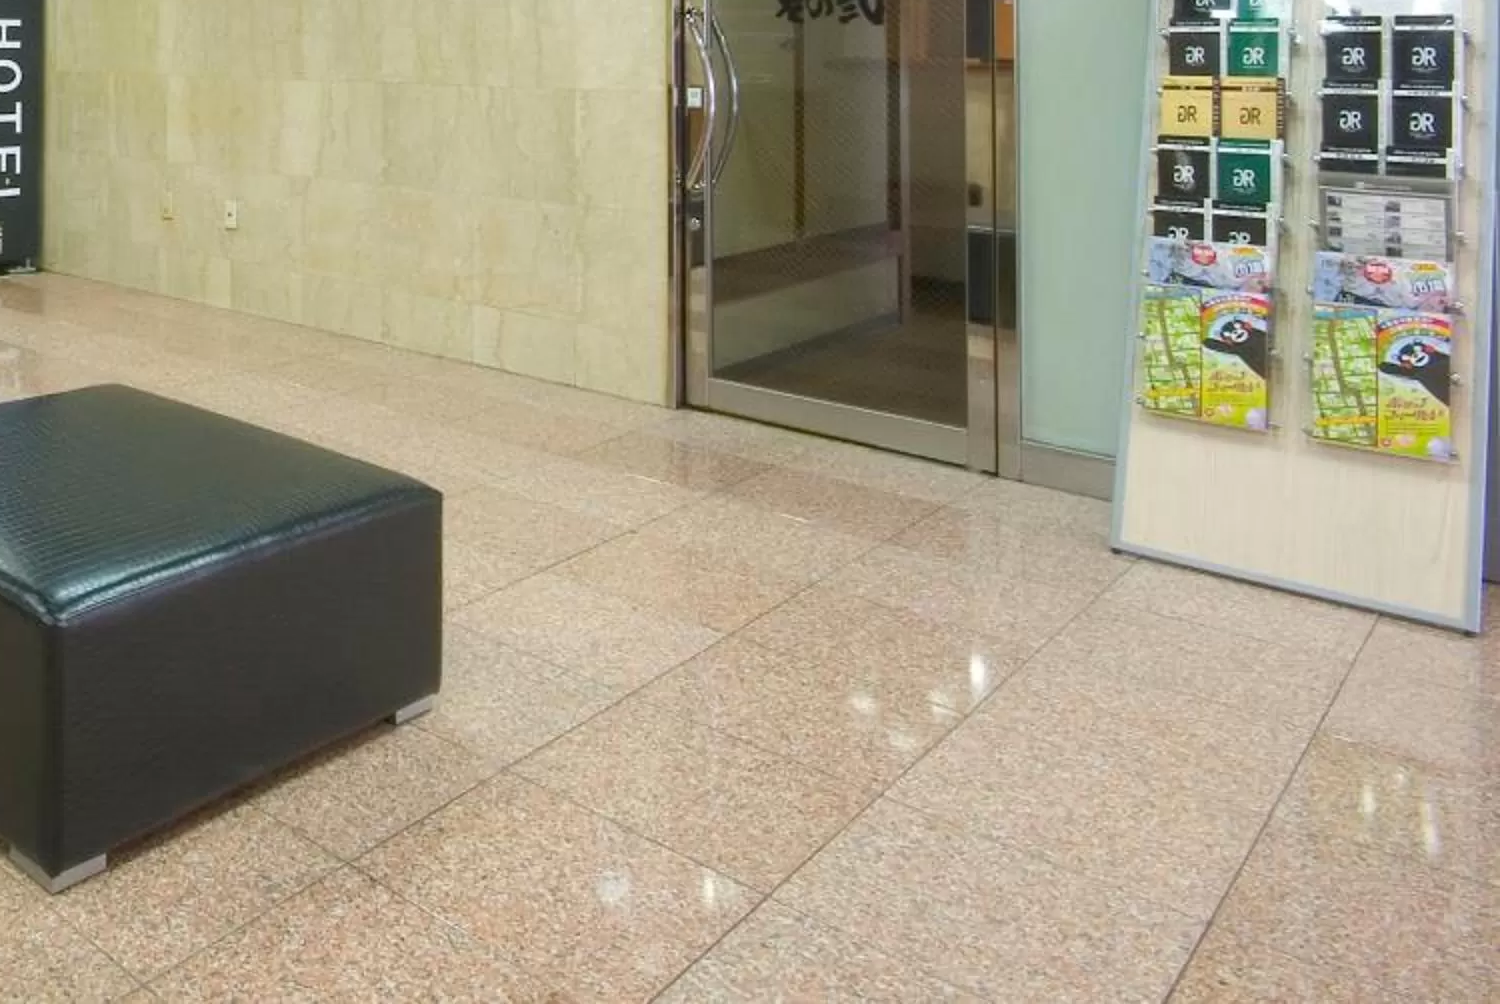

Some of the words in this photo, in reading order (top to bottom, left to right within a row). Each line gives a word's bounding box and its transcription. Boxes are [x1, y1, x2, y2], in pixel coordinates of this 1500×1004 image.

[1185, 46, 1206, 64] GR
[1242, 47, 1265, 65] GR
[1341, 47, 1365, 65] GR
[1411, 47, 1437, 67] GR
[1177, 105, 1198, 124] GR
[1239, 107, 1261, 126] GR
[1339, 110, 1362, 129] GR
[1409, 112, 1435, 133] GR
[1173, 165, 1195, 183] GR
[1232, 168, 1256, 187] GR
